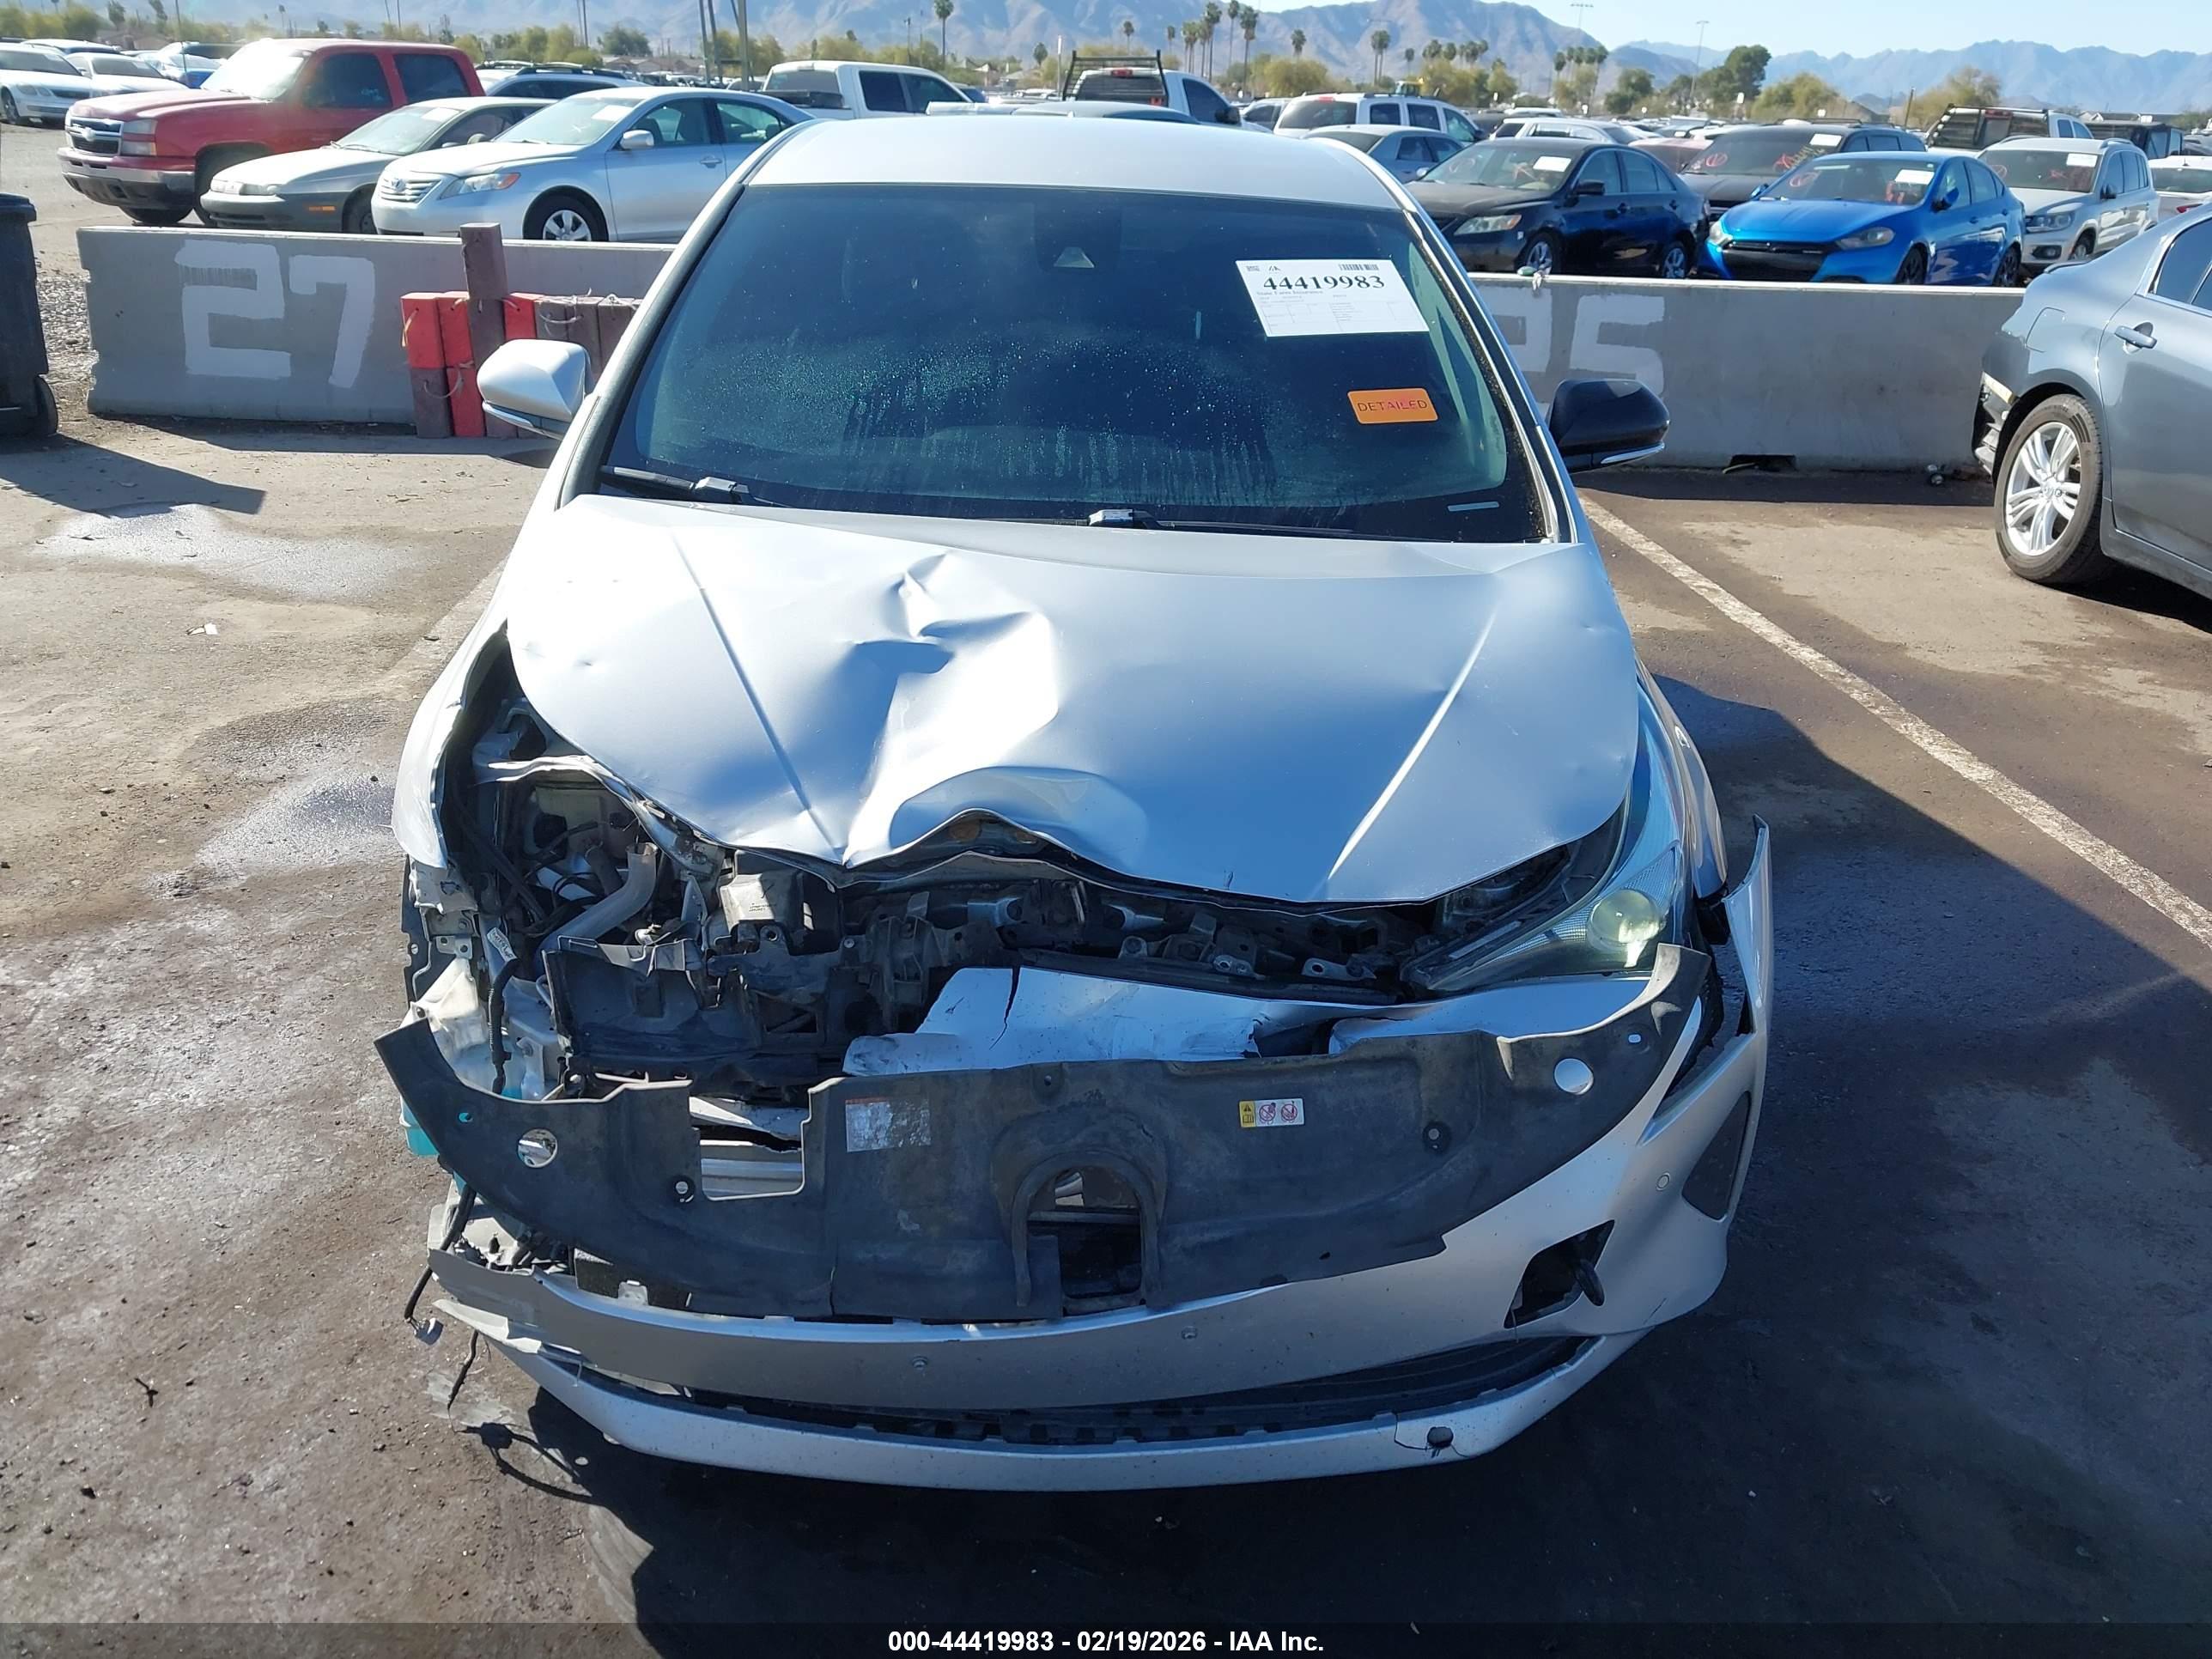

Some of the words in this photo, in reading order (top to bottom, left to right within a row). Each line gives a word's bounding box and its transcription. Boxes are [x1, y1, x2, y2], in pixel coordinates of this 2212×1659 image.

[1262, 275, 1385, 291] 44419983
[174, 239, 375, 389] 27
[1357, 399, 1429, 412] DETAILED
